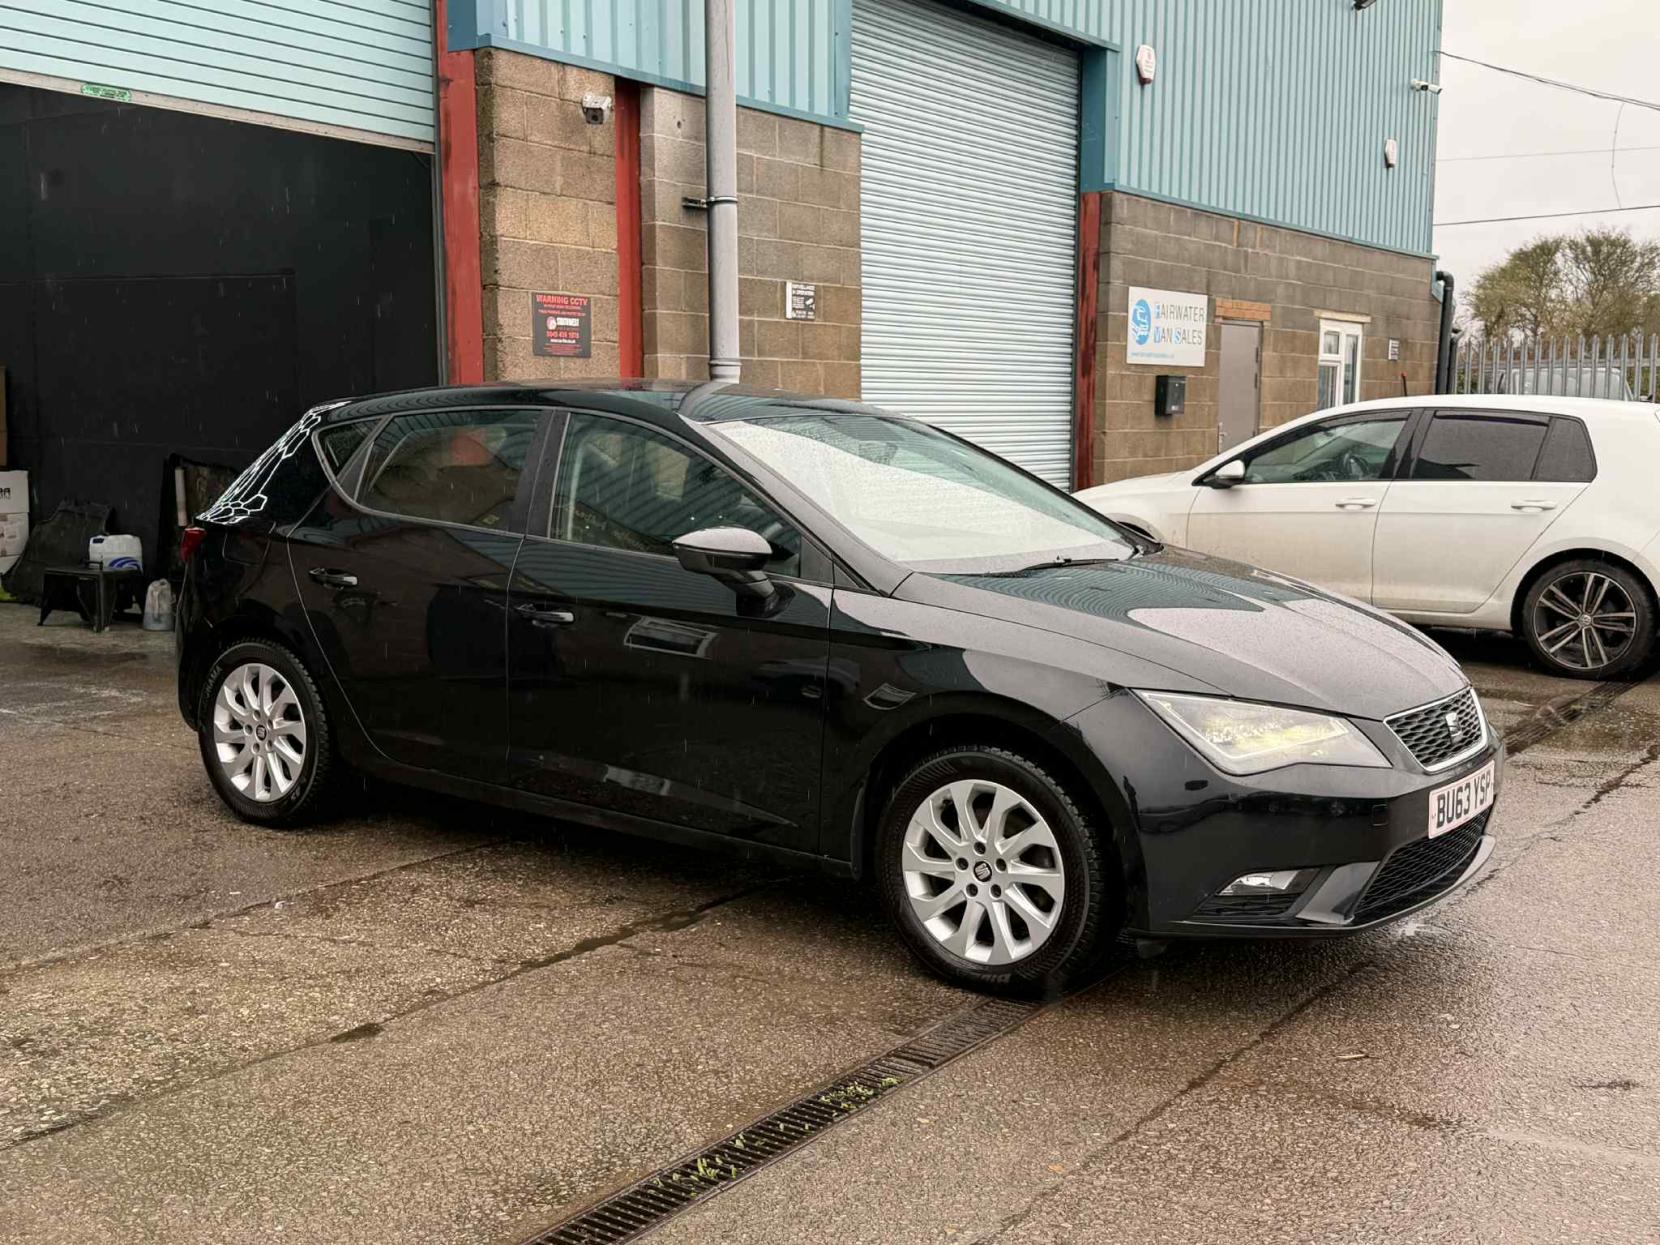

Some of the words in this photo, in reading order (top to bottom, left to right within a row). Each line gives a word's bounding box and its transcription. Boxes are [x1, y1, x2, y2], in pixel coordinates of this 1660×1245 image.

[536, 295, 569, 305] WARNING
[570, 297, 588, 306] CCTV
[1155, 303, 1205, 322] FAIRWATER
[1154, 326, 1173, 344] VAN
[1174, 327, 1203, 345] SALES
[1436, 782, 1470, 829] BU63
[1473, 770, 1492, 809] YSP
